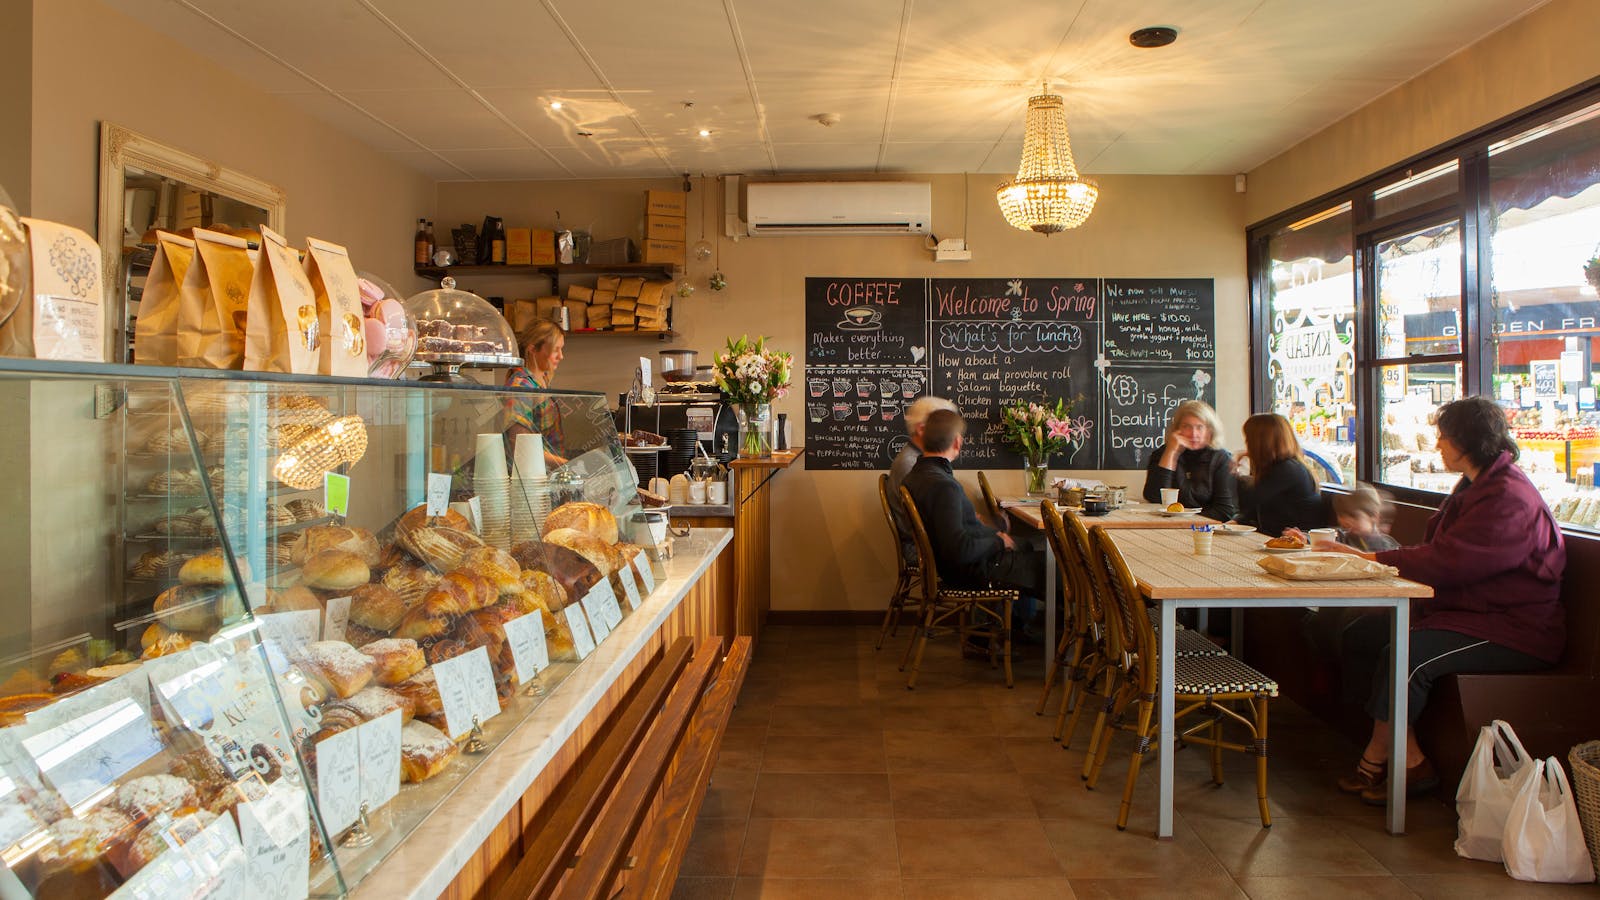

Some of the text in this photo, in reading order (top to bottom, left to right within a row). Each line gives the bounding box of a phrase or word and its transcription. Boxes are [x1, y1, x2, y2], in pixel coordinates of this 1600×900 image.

[827, 282, 902, 306] COFFEE
[1107, 284, 1123, 297] We
[1127, 287, 1144, 295] now
[936, 286, 1096, 320] Welcome to Spring
[1112, 313, 1130, 322] HAVE
[1132, 313, 1150, 322] HERE
[946, 326, 1080, 348] What's for lunch?
[1442, 321, 1544, 336] GDEN
[813, 330, 905, 349] Makes everything
[938, 354, 960, 368] How
[965, 354, 998, 367] about
[958, 366, 1072, 383] Ham and provolone roll
[957, 381, 1041, 397] Salami baguette
[1120, 379, 1188, 407] B is for
[958, 394, 992, 406] Chicken
[1110, 406, 1176, 428] beautif
[1111, 428, 1167, 449] bread
[960, 448, 996, 461] pecials
